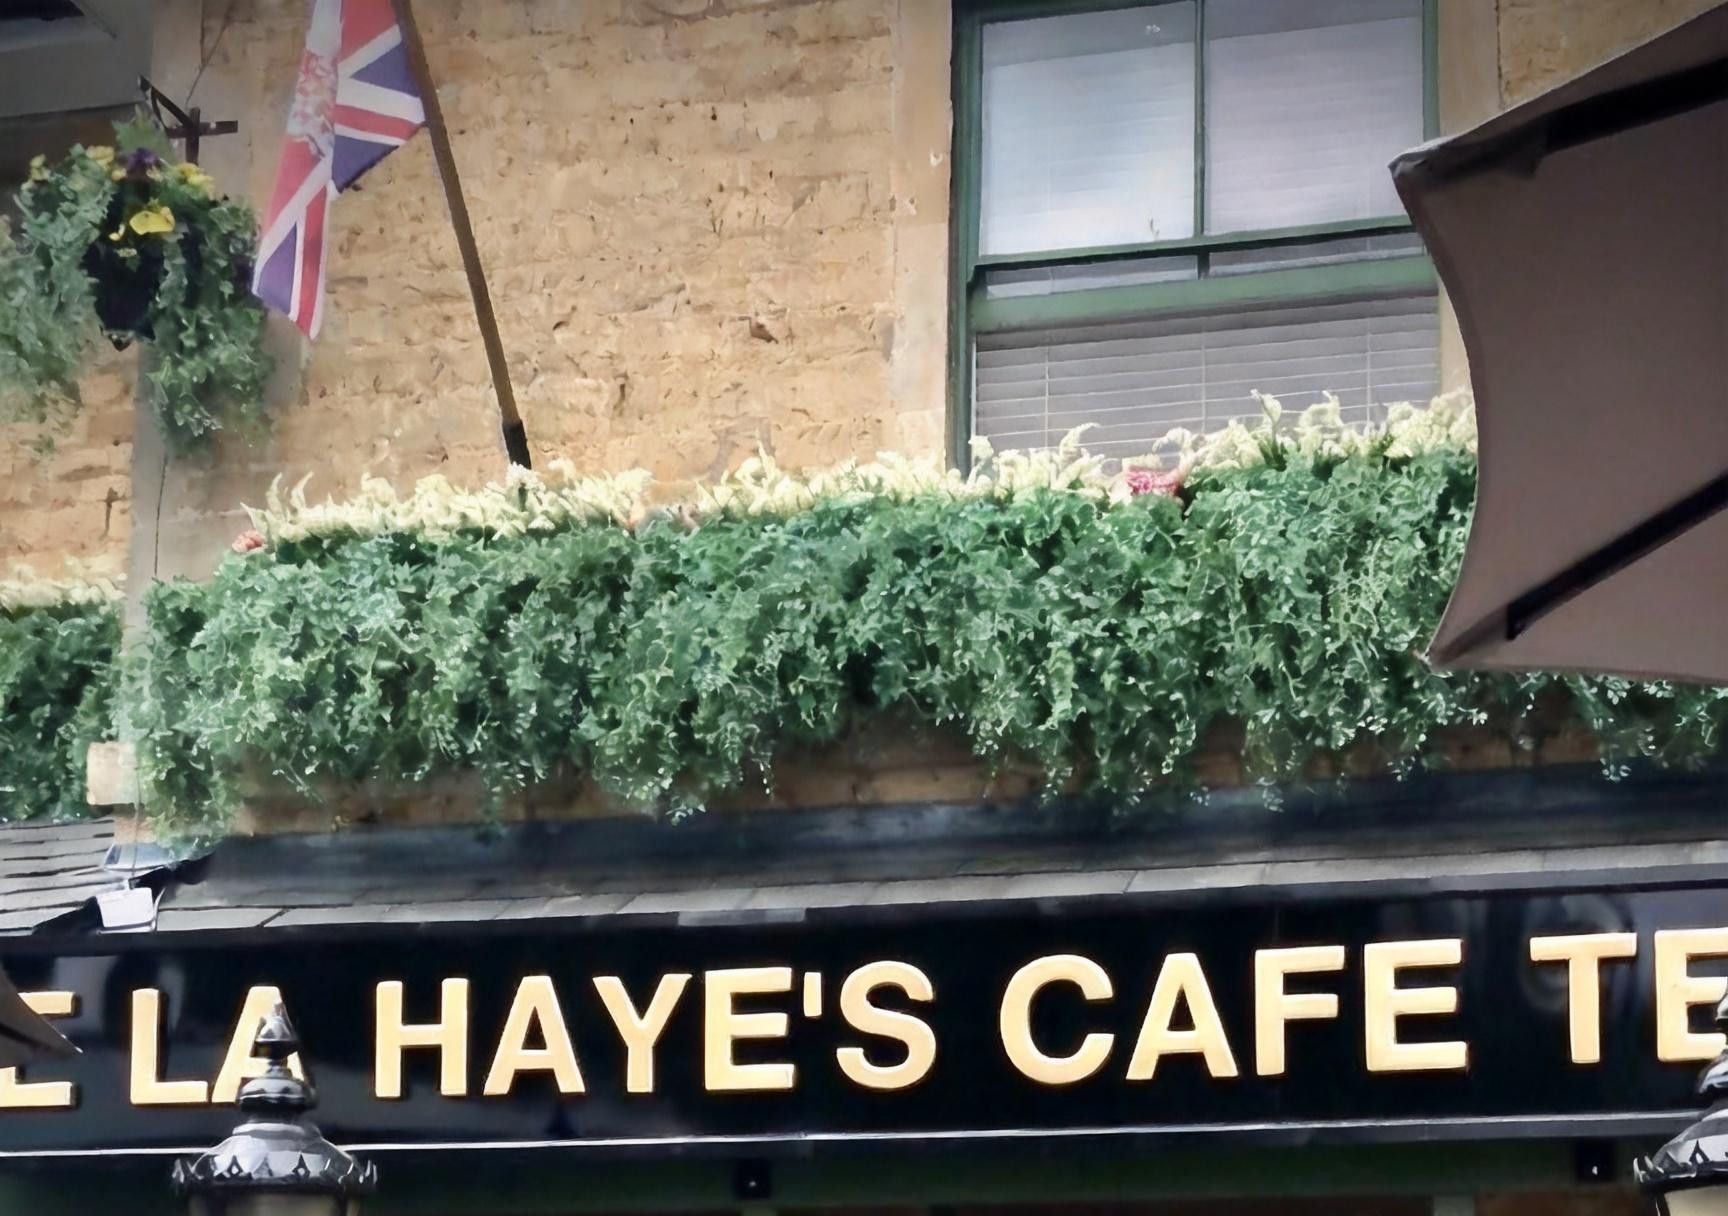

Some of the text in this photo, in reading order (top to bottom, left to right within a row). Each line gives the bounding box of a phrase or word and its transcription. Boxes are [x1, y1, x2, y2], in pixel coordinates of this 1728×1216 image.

[130, 985, 306, 1104] LA
[375, 960, 938, 1098] HAYE'S
[1000, 938, 1467, 1083] CAFE
[1530, 927, 1728, 1063] TE
